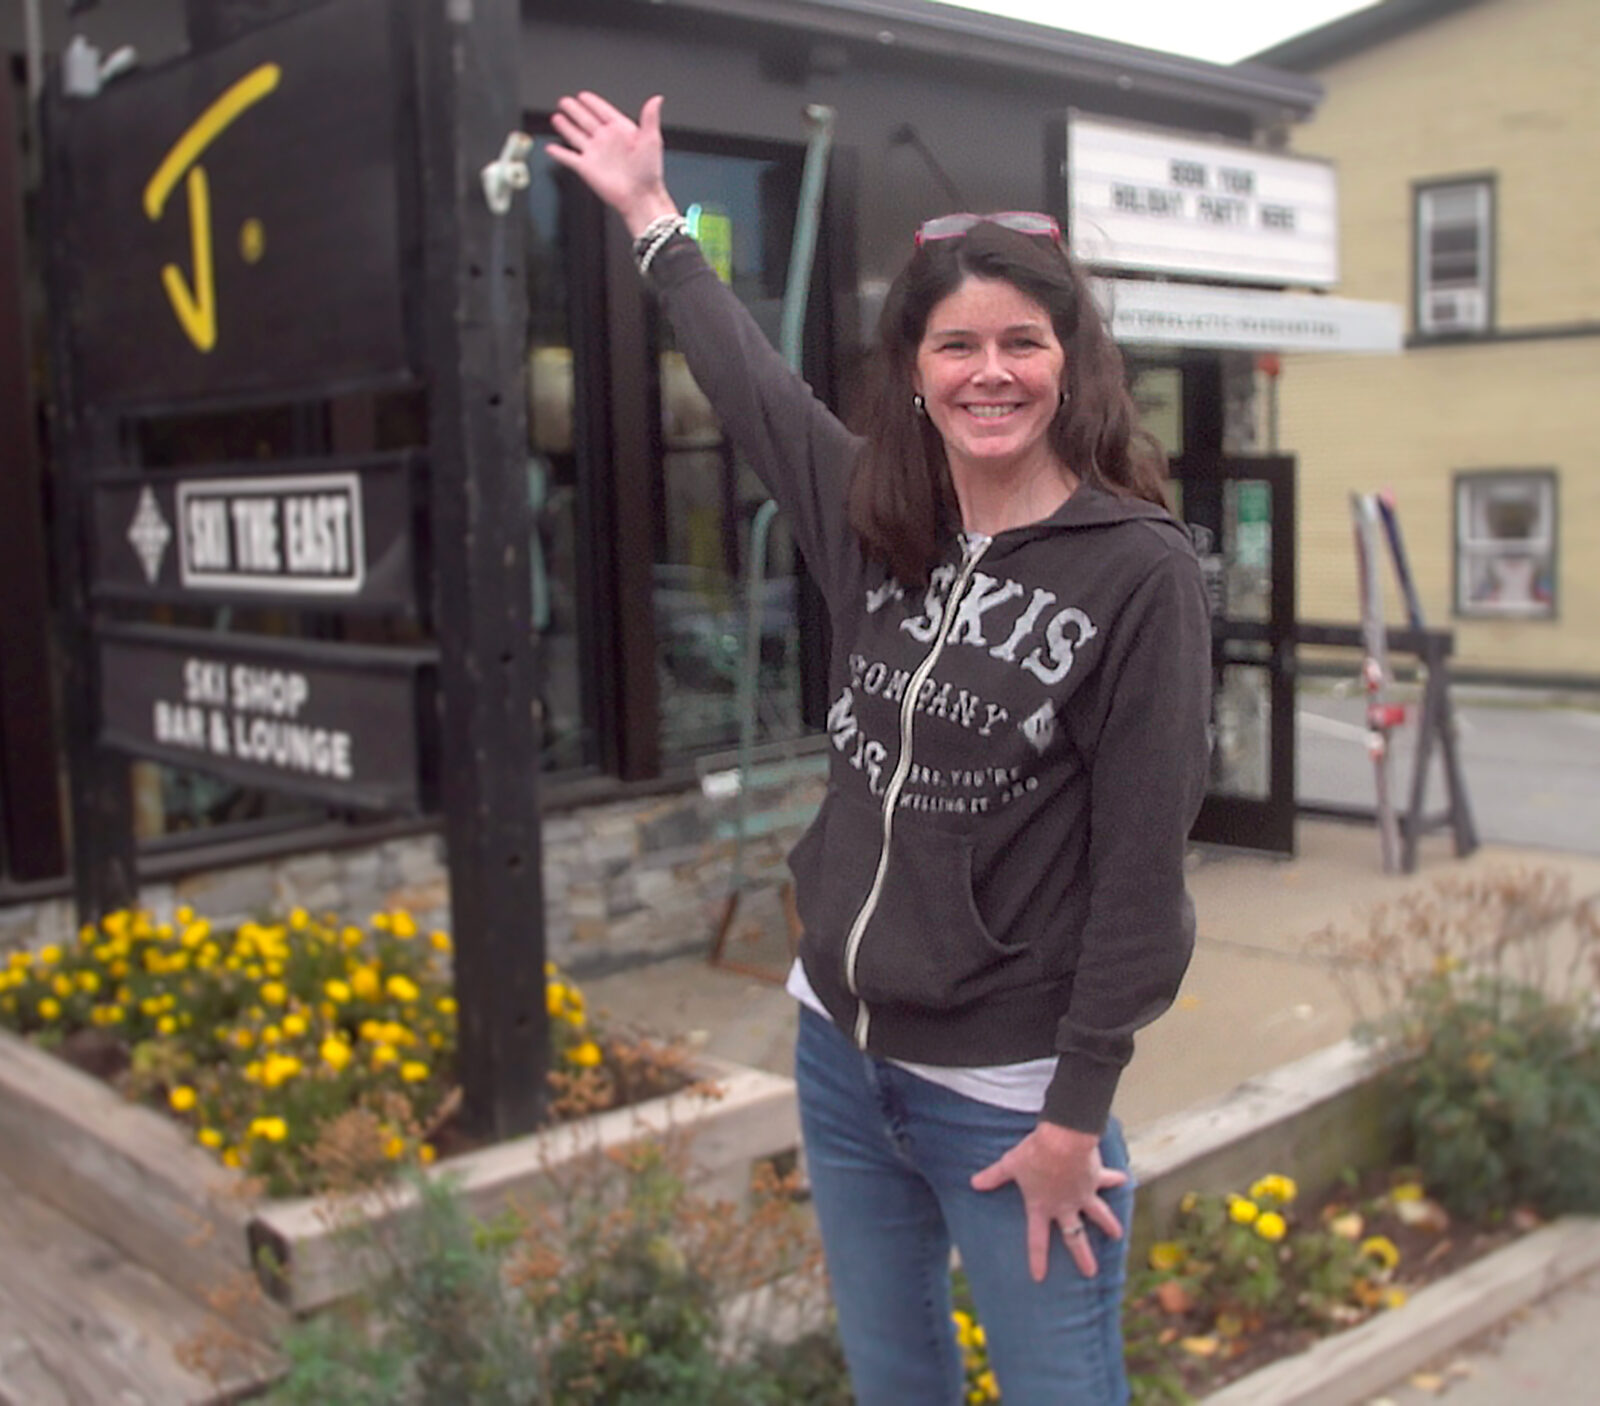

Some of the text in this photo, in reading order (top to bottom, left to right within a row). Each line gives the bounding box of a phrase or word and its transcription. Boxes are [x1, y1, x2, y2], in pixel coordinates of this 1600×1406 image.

[189, 494, 350, 573] SKI THE EAST
[900, 563, 1097, 685] SKIS
[184, 657, 309, 716] SKI SHOP
[849, 653, 1008, 736] COMPANY
[154, 700, 353, 779] BAR & LOUNGE
